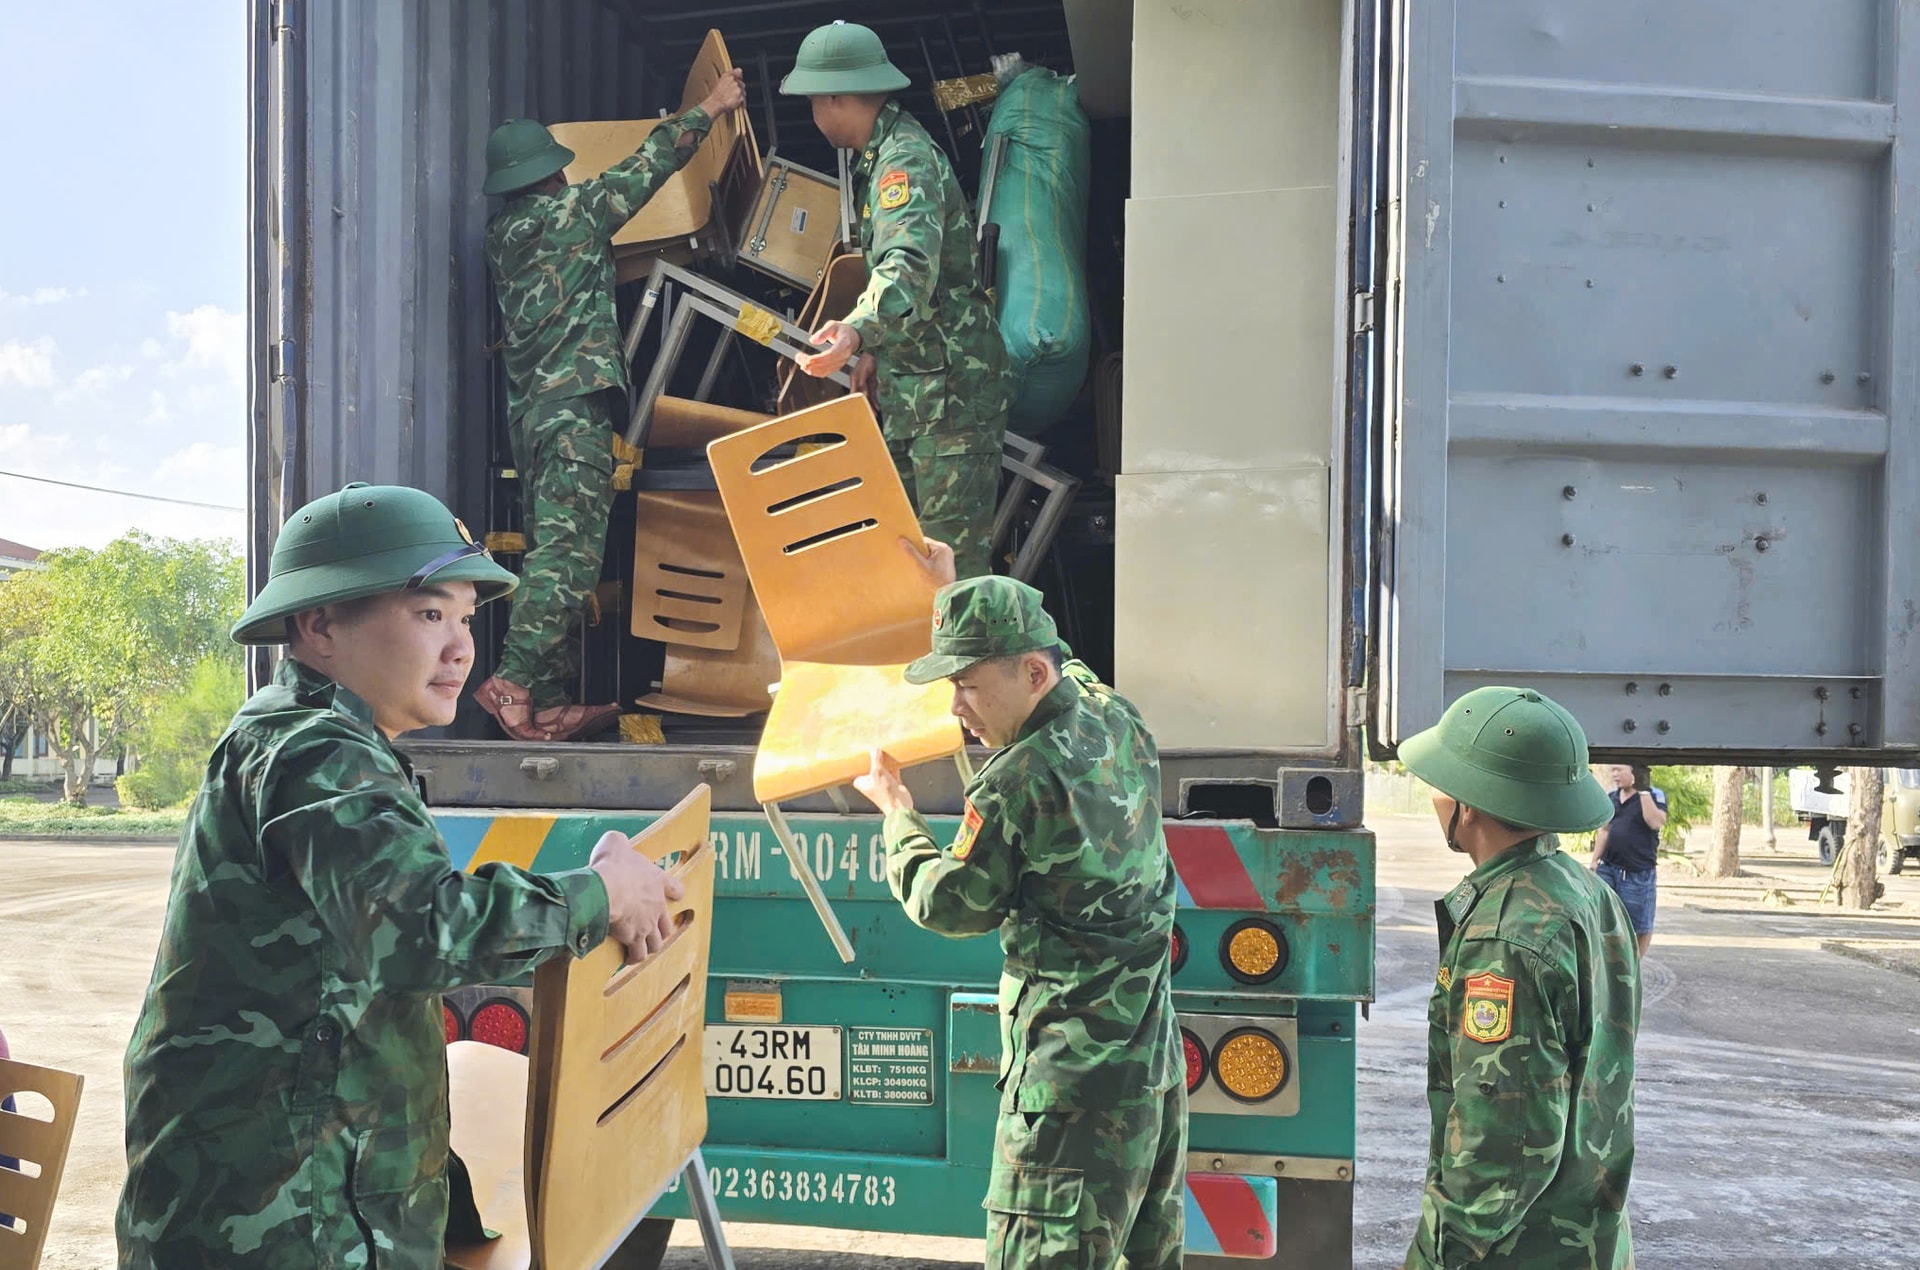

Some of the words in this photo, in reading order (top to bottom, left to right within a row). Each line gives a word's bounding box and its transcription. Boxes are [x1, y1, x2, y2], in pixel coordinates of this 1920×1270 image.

[858, 1032, 874, 1040] CTY
[876, 1032, 899, 1041] TNHH
[900, 1032, 922, 1041] DVVT
[730, 1030, 810, 1060] 43RM
[872, 1044, 896, 1056] MINH
[853, 1064, 882, 1073] KLBT:
[890, 1065, 927, 1075] 7510KG
[716, 1064, 826, 1095] 004.60
[853, 1077, 882, 1086] KLCP:
[883, 1078, 927, 1087] 30490KG
[853, 1089, 882, 1099] KLTB:
[884, 1091, 928, 1100] 38000KG
[709, 1167, 896, 1206] 02363834783
